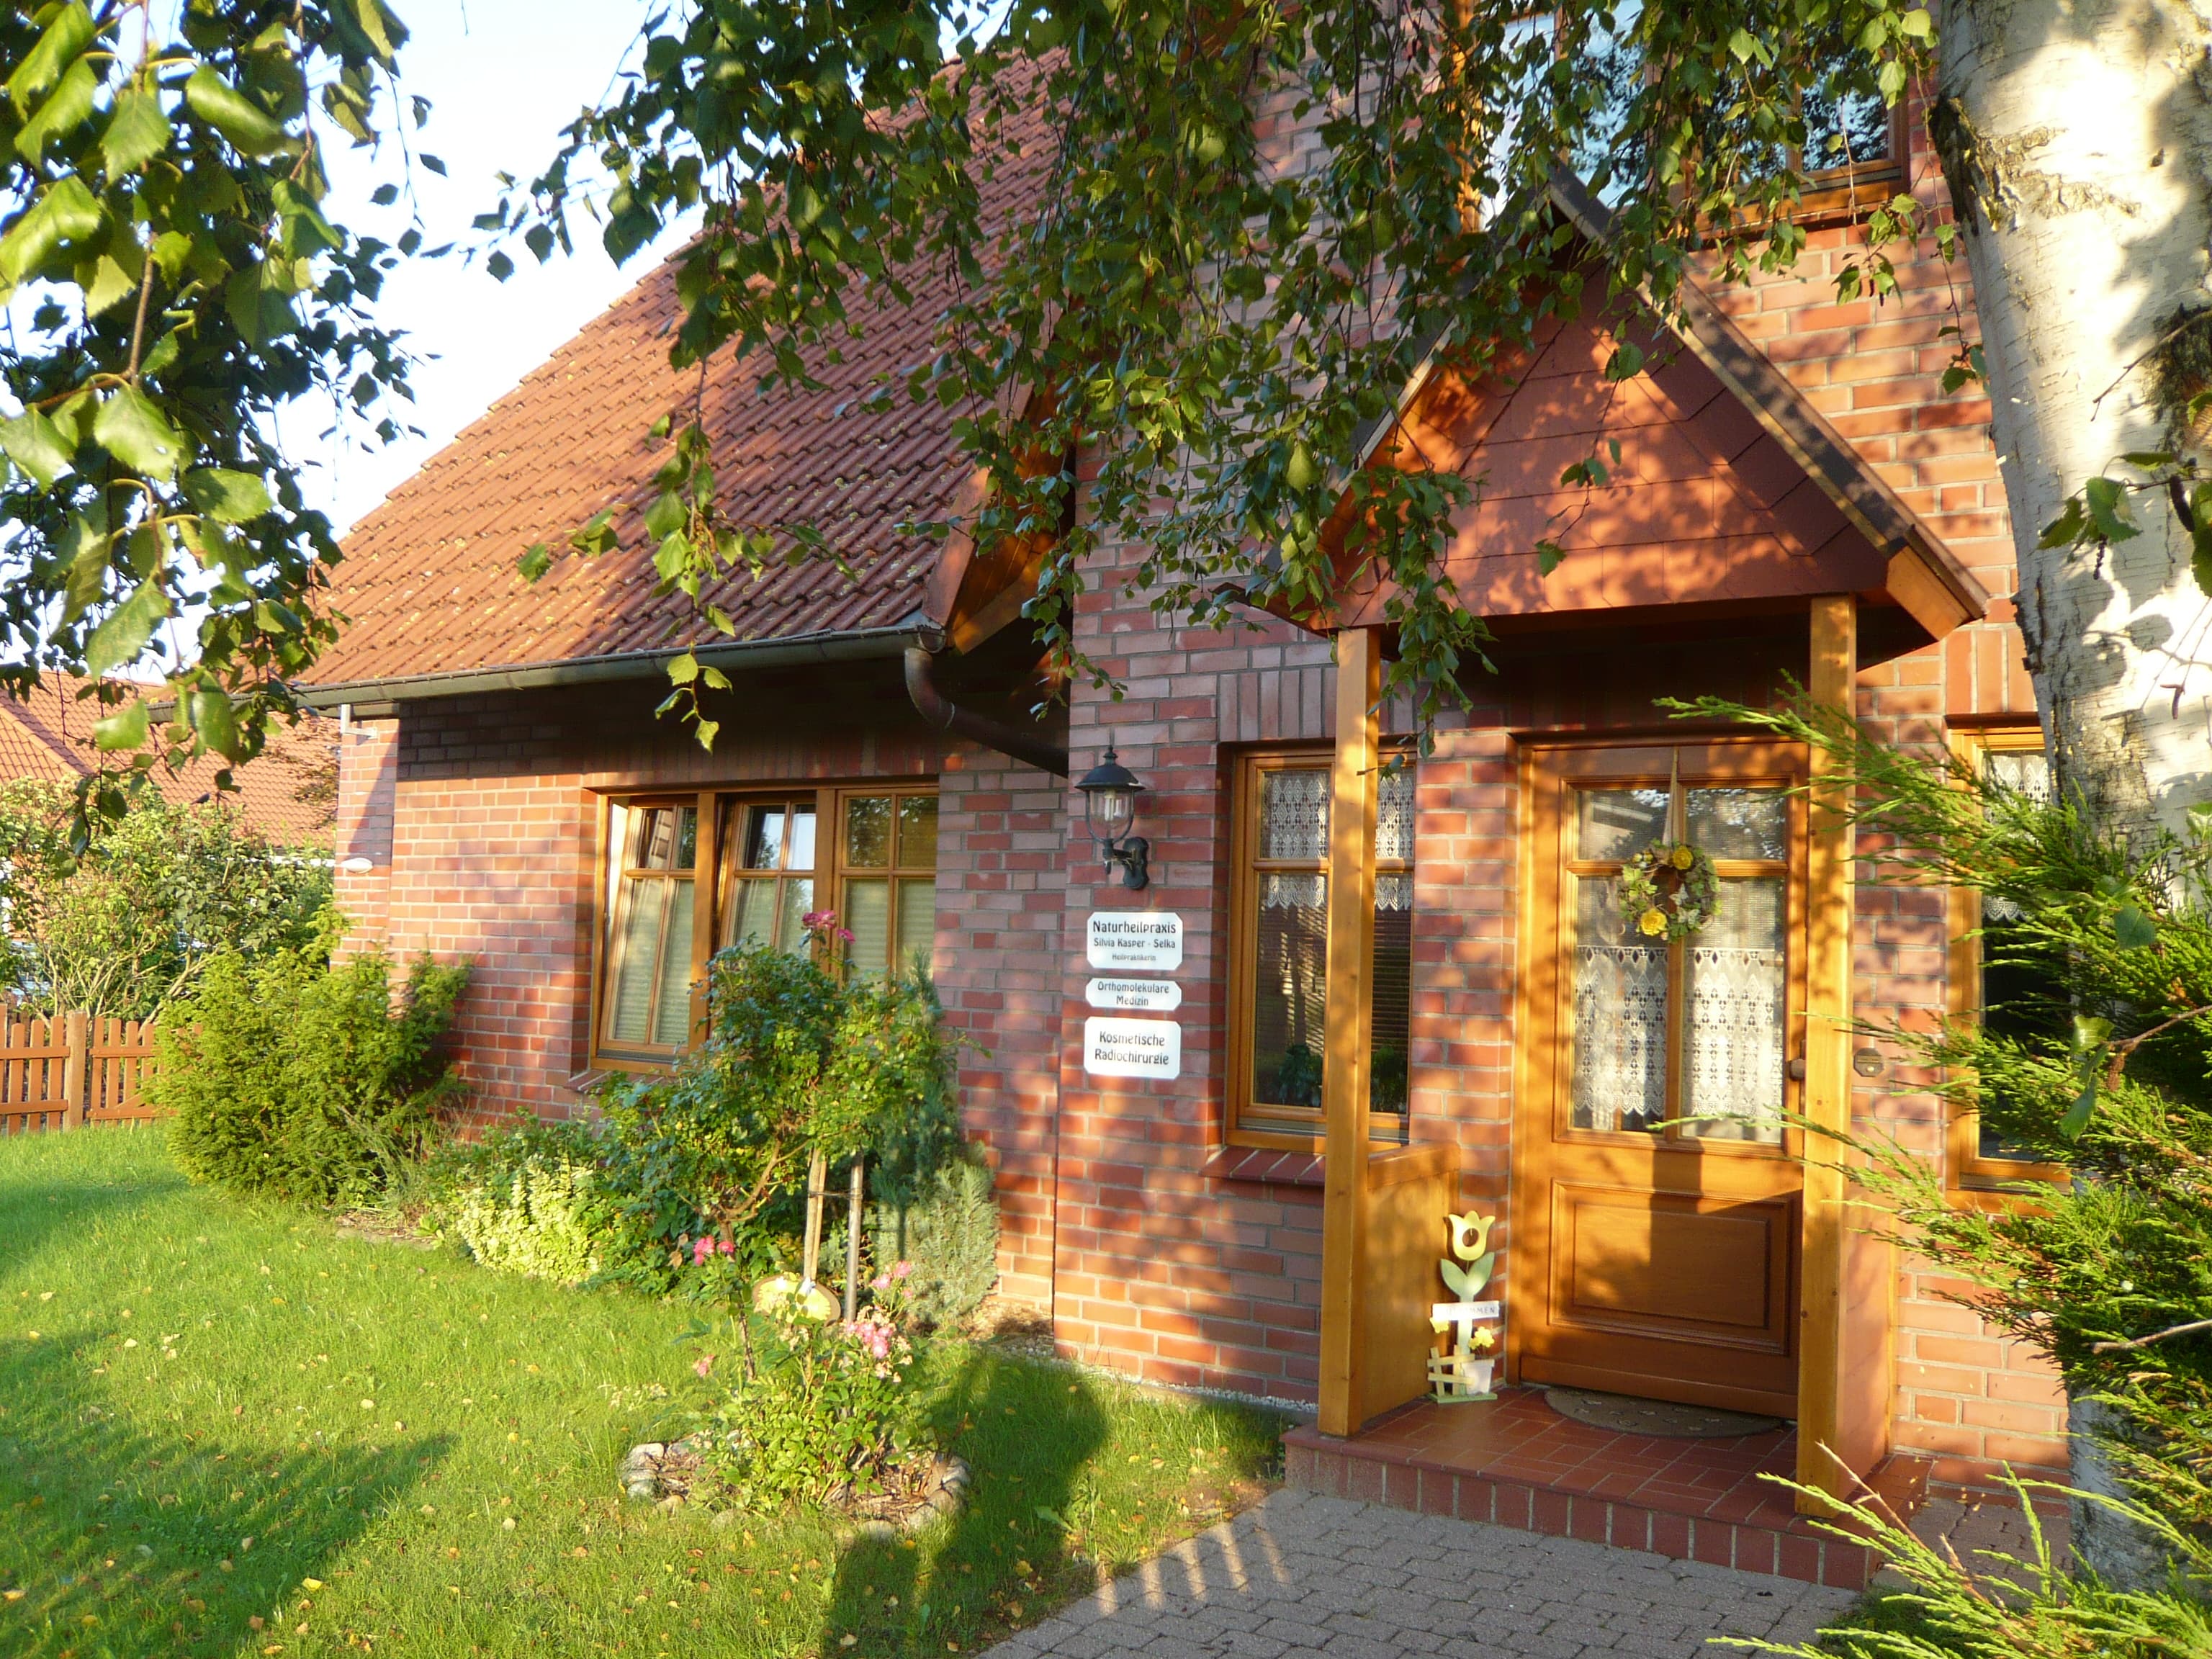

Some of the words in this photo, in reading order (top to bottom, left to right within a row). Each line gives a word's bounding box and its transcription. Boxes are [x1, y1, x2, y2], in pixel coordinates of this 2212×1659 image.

[1093, 920, 1176, 934] Naturheilpraxis
[1094, 938, 1115, 947] Silvia
[1118, 938, 1145, 948] Kasper
[1154, 939, 1176, 948] Selka
[1097, 981, 1169, 994] Orthomolekulare
[1116, 995, 1148, 1006] Medizin
[1100, 1031, 1165, 1046] Kosmetische
[1094, 1048, 1169, 1065] Radiochirurgie
